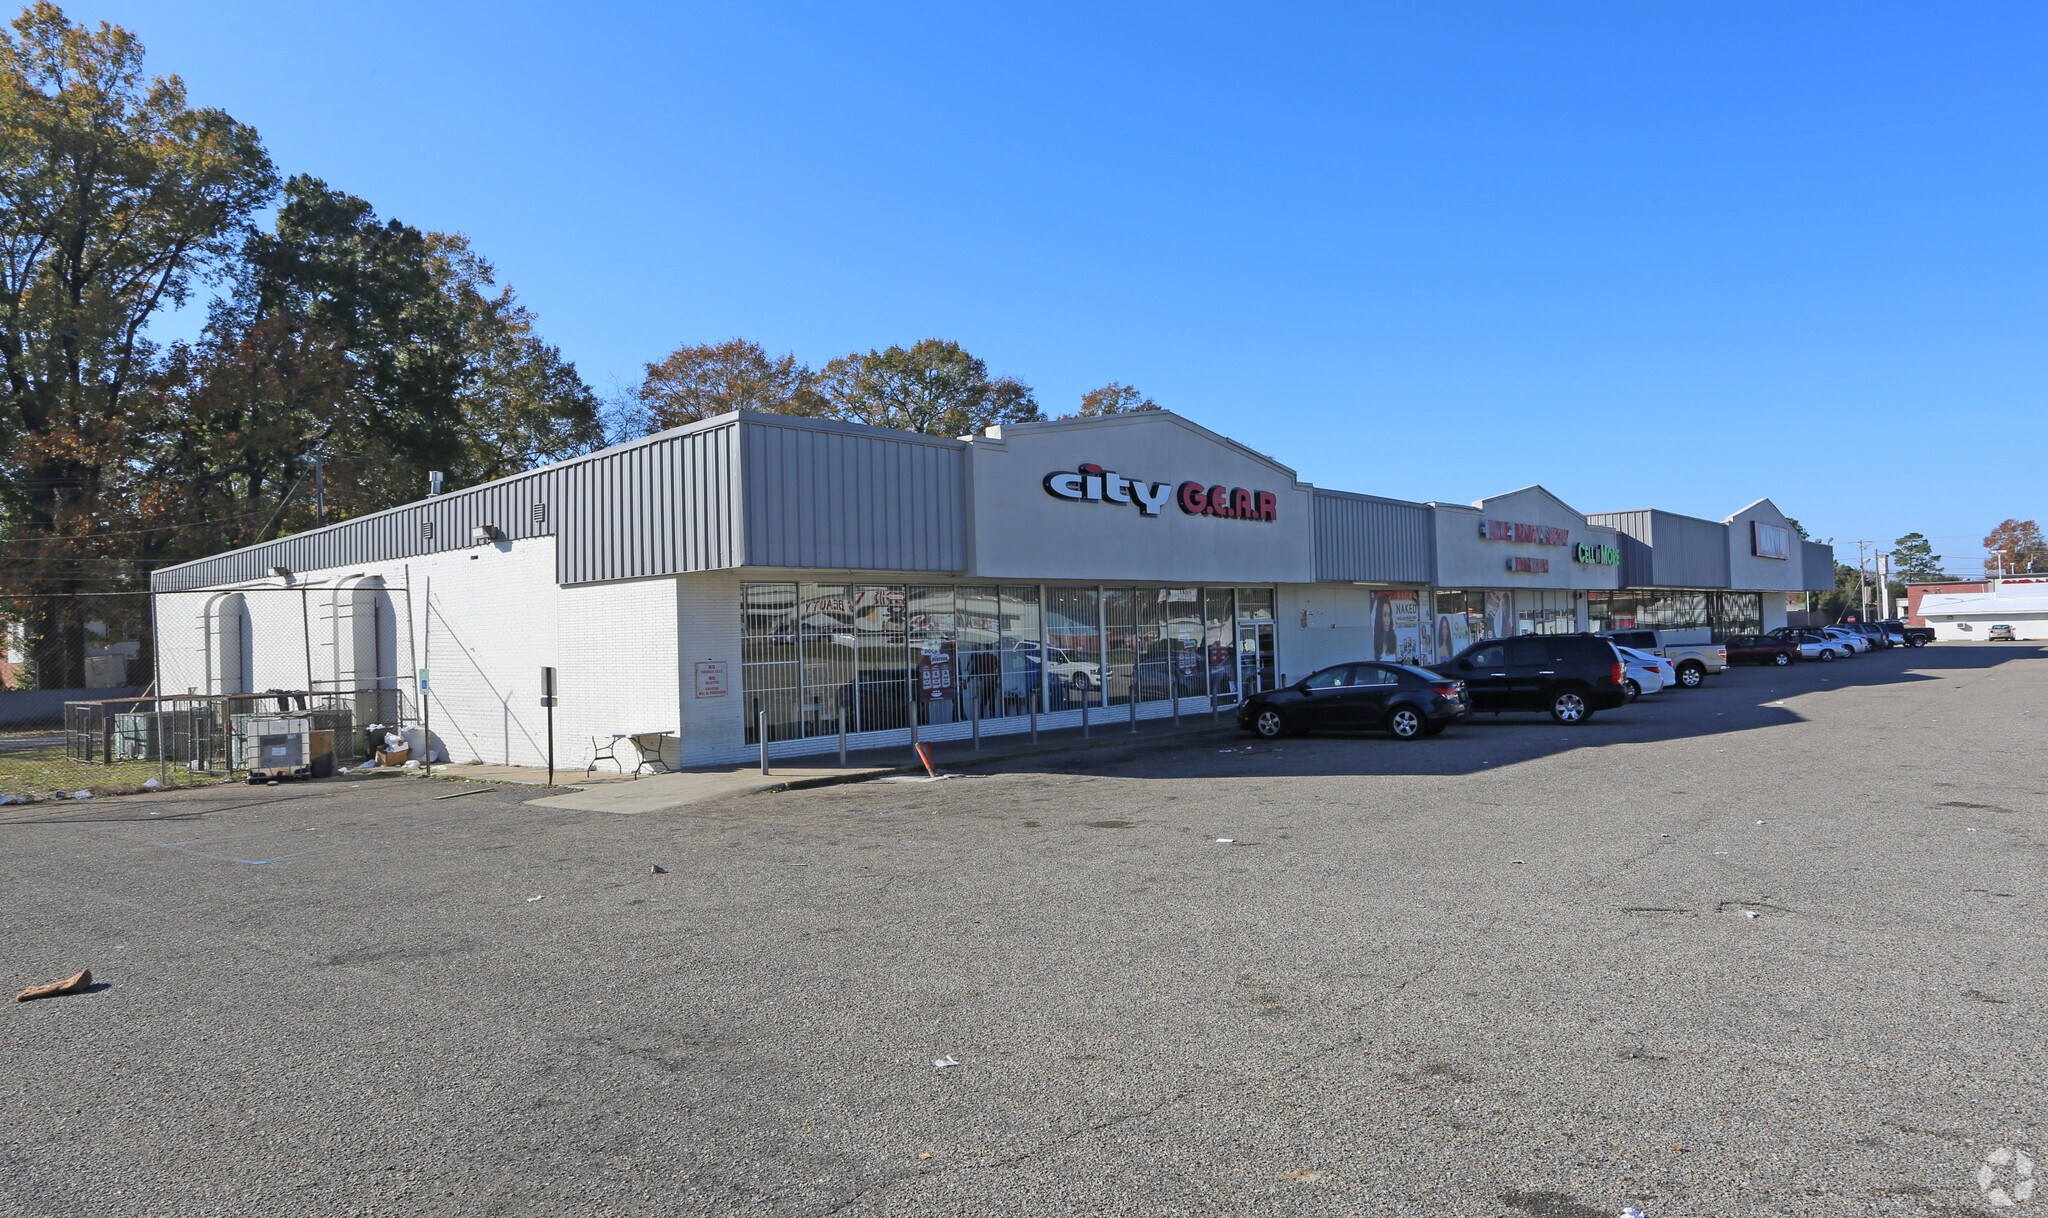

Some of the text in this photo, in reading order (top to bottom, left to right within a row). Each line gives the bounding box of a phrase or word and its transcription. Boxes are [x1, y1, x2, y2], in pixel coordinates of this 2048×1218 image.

[1578, 542, 1620, 565] CELL MORE
[1396, 604, 1417, 614] NAKED
